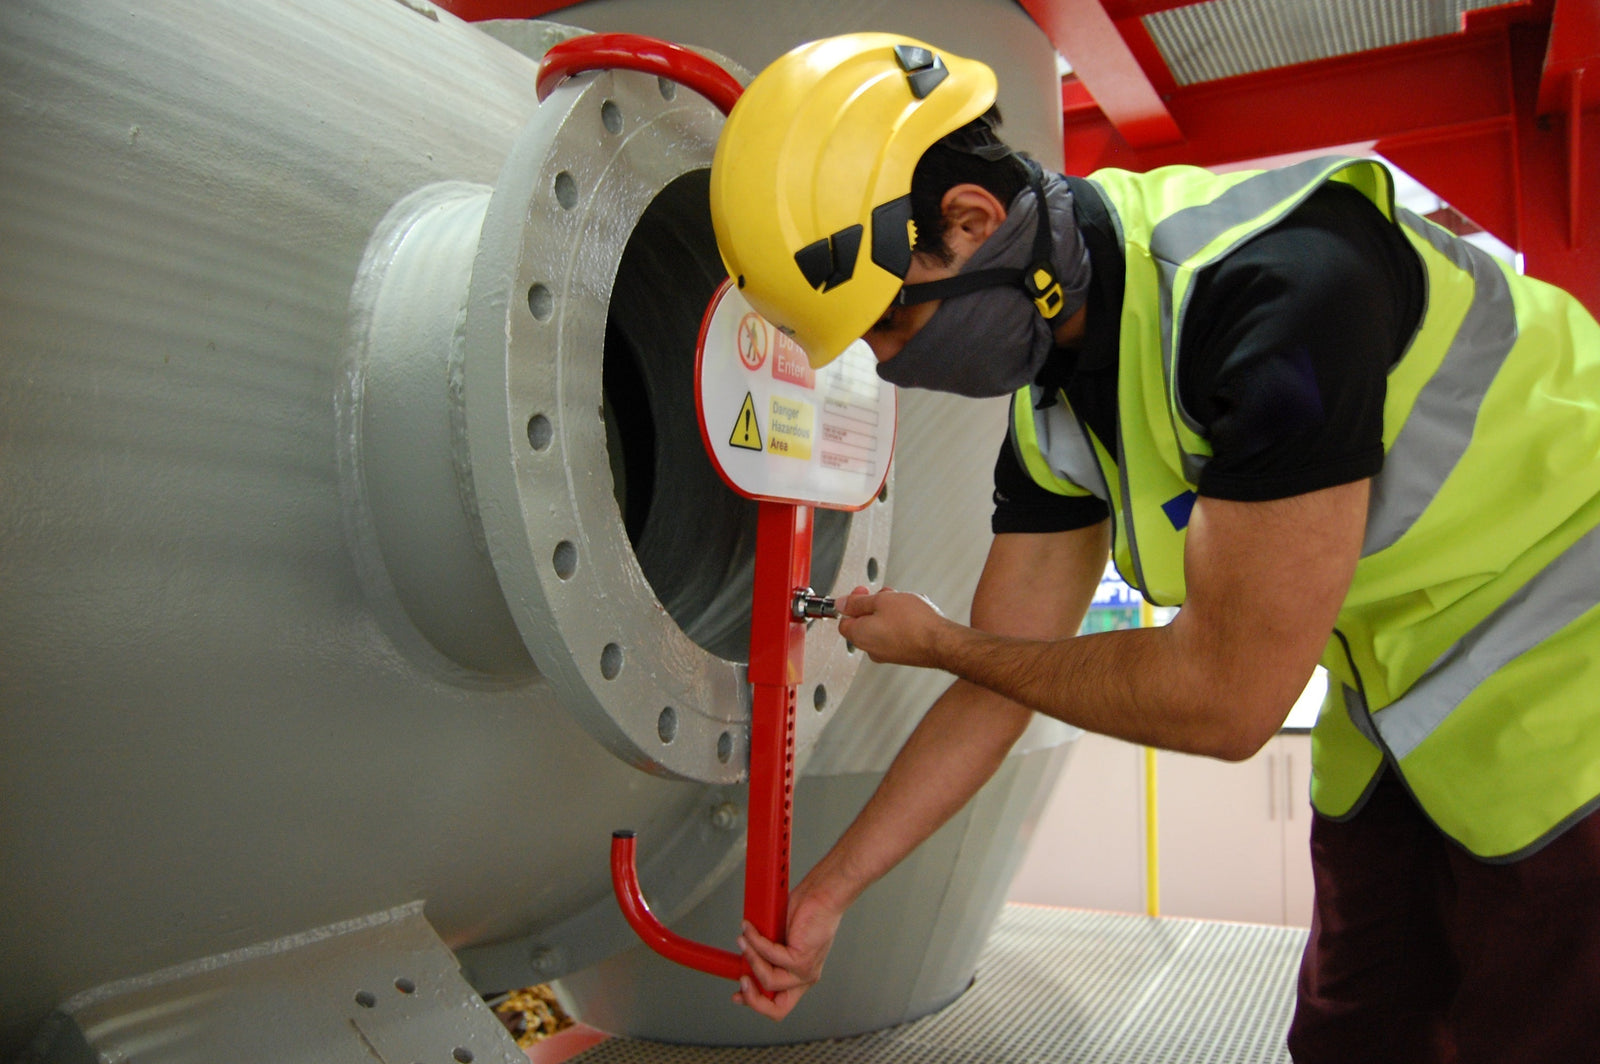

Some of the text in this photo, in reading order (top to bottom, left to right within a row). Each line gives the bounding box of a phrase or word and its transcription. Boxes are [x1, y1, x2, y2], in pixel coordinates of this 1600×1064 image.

[779, 333, 794, 350] Do
[778, 355, 805, 379] Enter
[773, 400, 800, 420] Danger
[772, 419, 810, 438] Hazardous
[770, 437, 788, 452] Area
